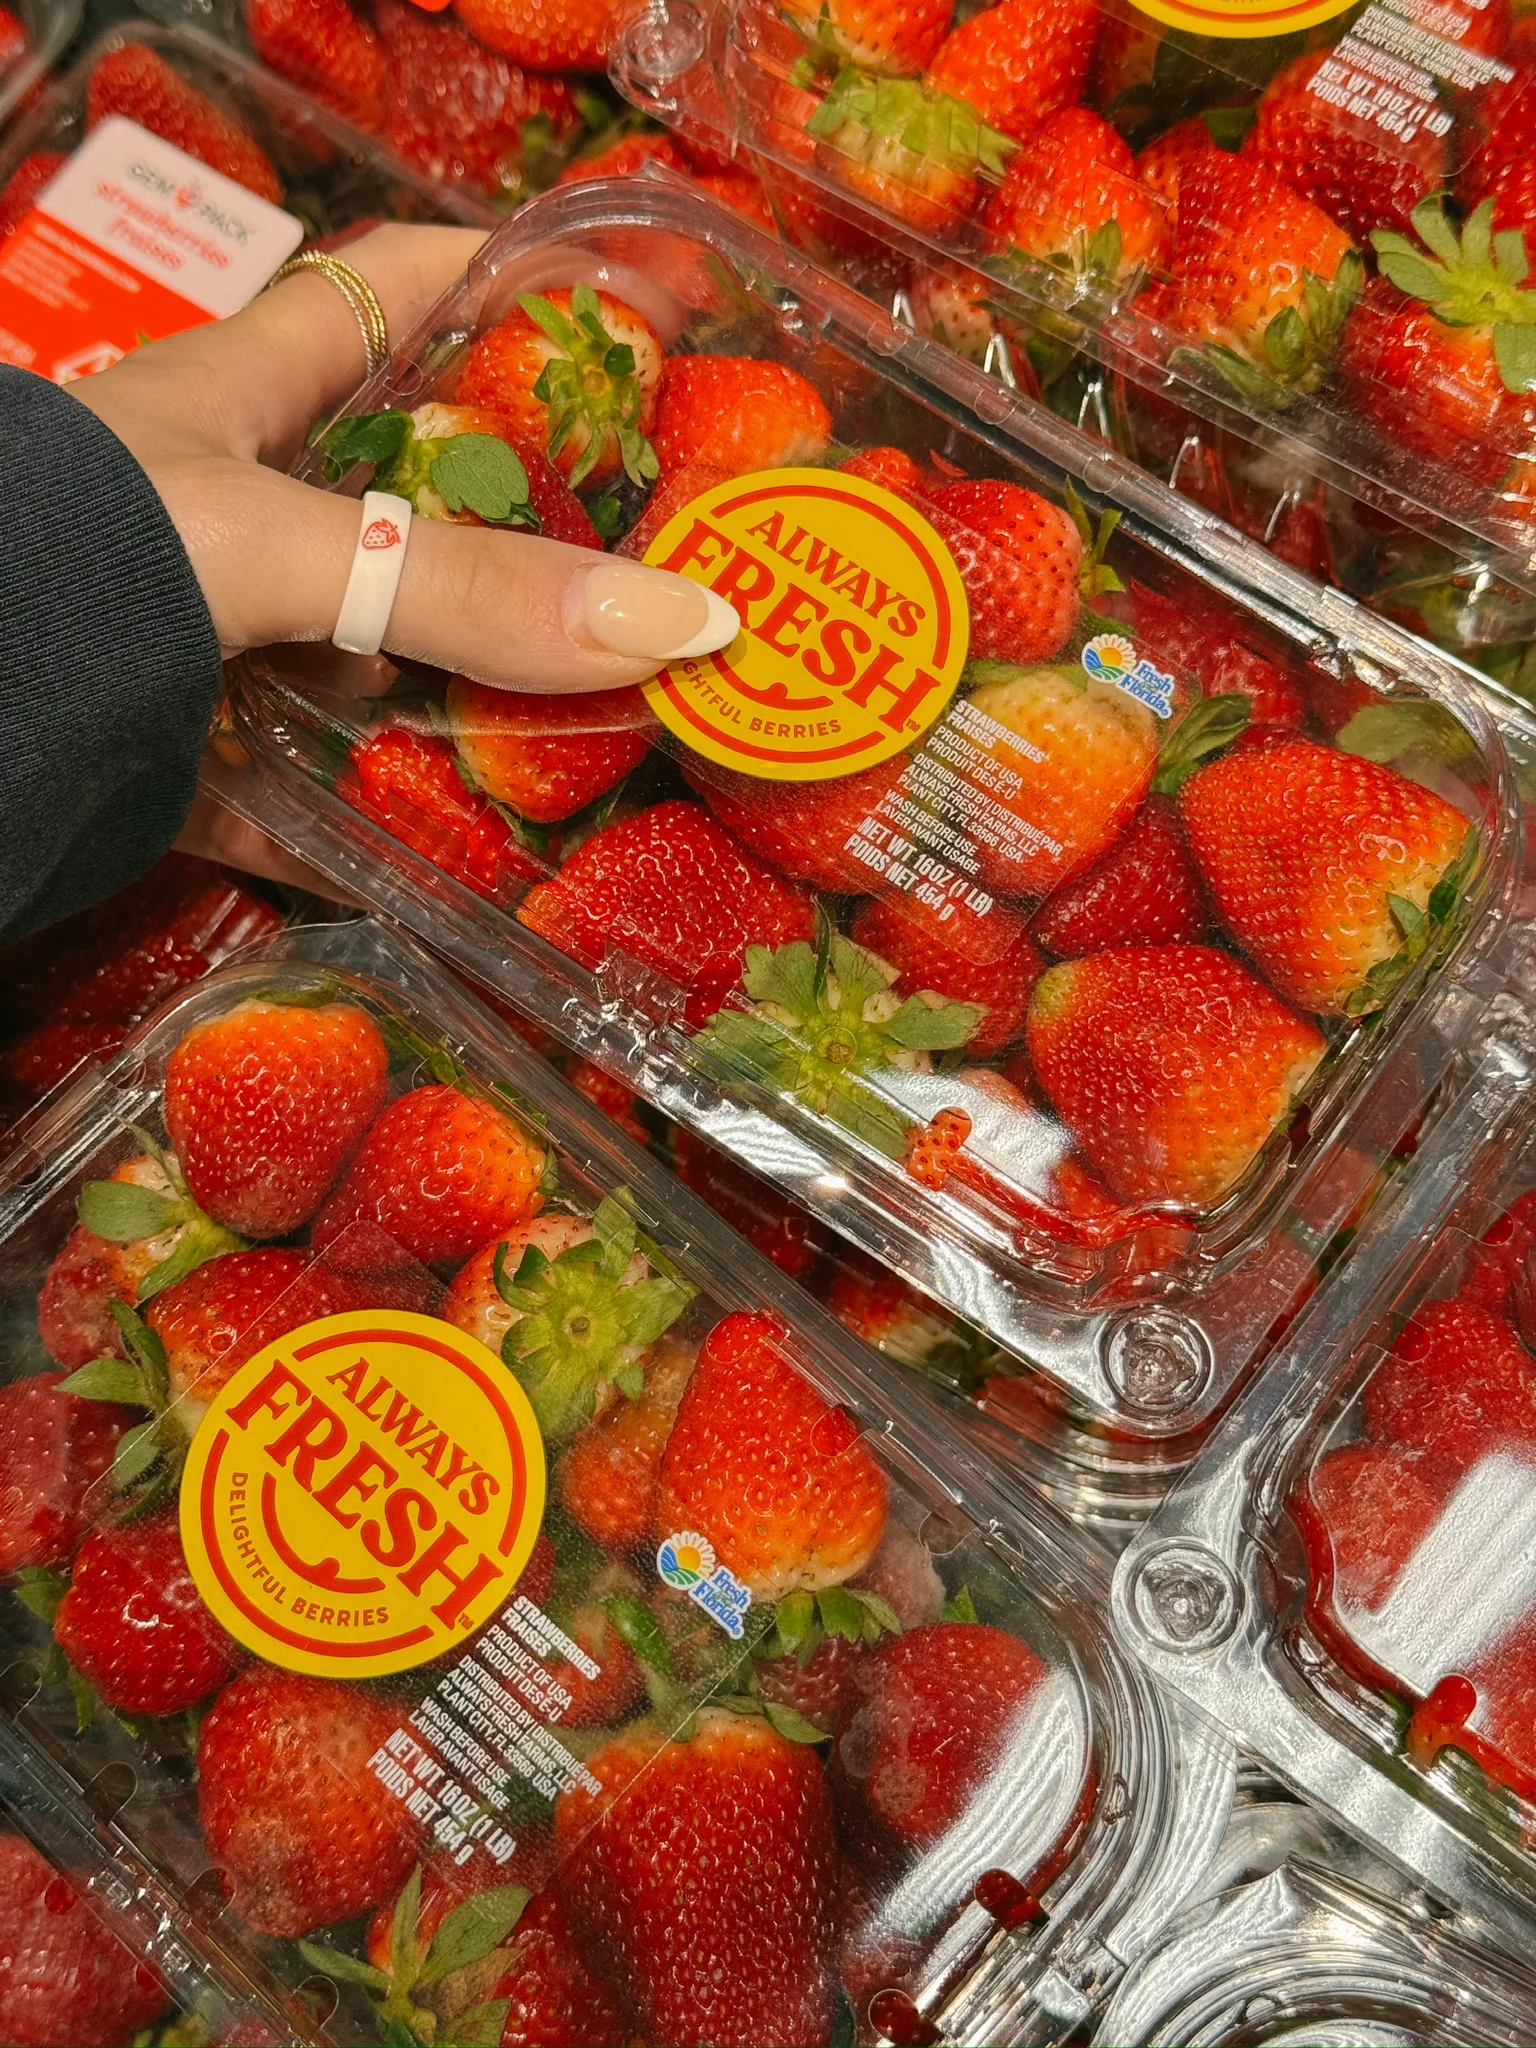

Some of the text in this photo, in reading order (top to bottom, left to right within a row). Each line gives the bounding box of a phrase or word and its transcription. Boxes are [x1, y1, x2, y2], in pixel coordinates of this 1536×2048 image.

[1338, 37, 1432, 87] WASH BEFORE USE
[1349, 25, 1387, 47] PLANT
[1450, 73, 1476, 90] USA
[1355, 15, 1402, 41] ALWAYS
[1398, 36, 1433, 56] FRESH
[1304, 76, 1352, 107] POIDS
[1345, 96, 1380, 121] NET
[1316, 60, 1351, 85] NET
[1343, 72, 1377, 98] WT
[745, 510, 926, 637] ALWAYS
[680, 657, 842, 738] GHTFUL BERRIES
[1135, 663, 1171, 694] Fresh
[925, 737, 976, 773] PRODUIT
[971, 767, 998, 788] DES
[934, 726, 1024, 788] PRODUCT OF USA
[945, 711, 997, 748] FRAISES
[952, 699, 1047, 763] STRAWBERRIES
[857, 816, 891, 846] NET
[885, 835, 917, 863] WT
[875, 800, 980, 874] LAVER AVANT USAGE
[883, 789, 978, 856] WASH BEFORE USE
[896, 774, 934, 803] PLANT
[929, 797, 958, 820] CITY,
[955, 813, 971, 828] FL
[967, 821, 999, 846] 33566
[904, 764, 1039, 856] ALWAYS FRESH FARMS, LLC
[912, 753, 977, 798] DISTRIBUTED
[974, 792, 992, 808] BY
[990, 803, 1044, 842] DISTRIBUÉ
[1039, 836, 1063, 856] PAR
[843, 833, 955, 921] POIDS NET 454 g
[325, 1357, 500, 1515] ALWAYS
[226, 1359, 504, 1631] FRESH
[229, 1472, 390, 1627] DELIGHTFUL BERRIES
[712, 1569, 748, 1608] Fresh
[486, 1624, 574, 1709] PRODUCT OF USA
[501, 1607, 552, 1657] FRAISES
[511, 1594, 602, 1681] STRAWBERRIES
[475, 1637, 525, 1686] PRODUIT
[518, 1678, 545, 1705] DES
[385, 1727, 421, 1766] NET
[410, 1753, 444, 1789] WT
[408, 1708, 509, 1811] LAVER AVANT USAGE
[419, 1696, 510, 1788] WASH BEFORE USE
[436, 1679, 558, 1801] PLANT CITY, FL 33566 USA
[447, 1666, 576, 1794] ALWAYS FRESH FARMS, LLC
[458, 1655, 521, 1717] DISTRIBUTED
[515, 1710, 534, 1730] BY
[531, 1725, 583, 1777] DISTRIBUÉ
[577, 1769, 602, 1796] PAR
[366, 1747, 474, 1866] POIDS NET 454 g
